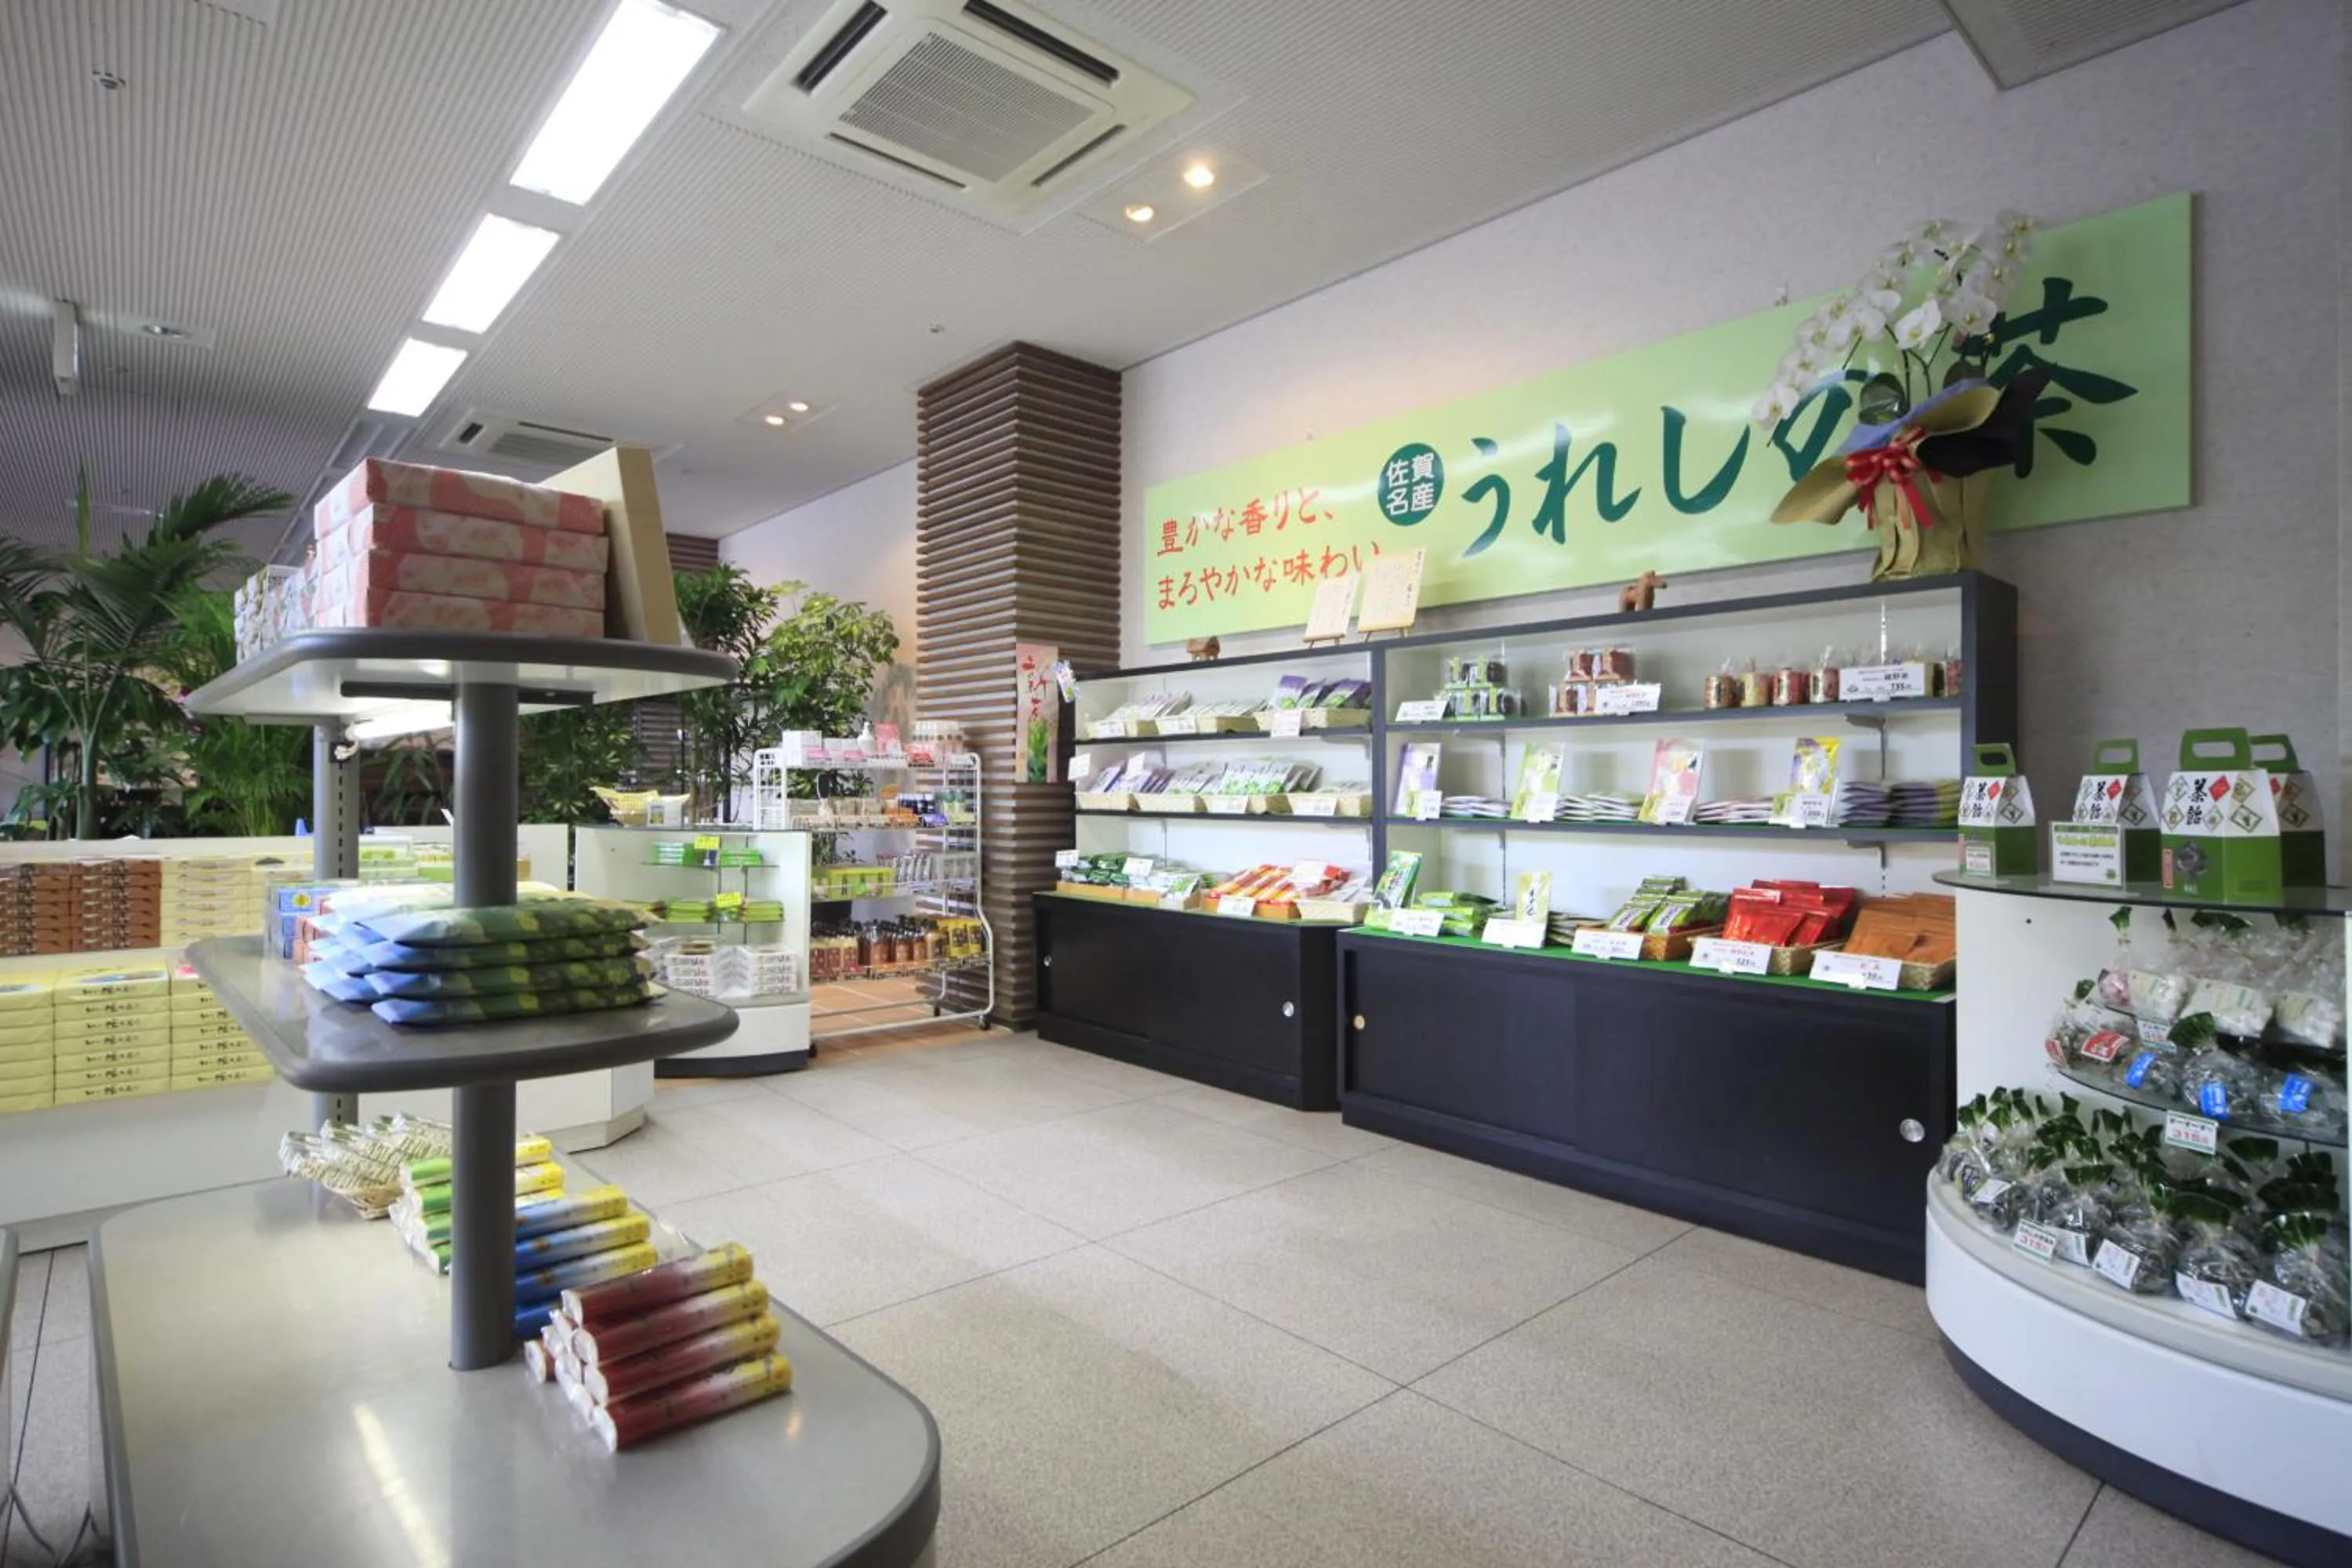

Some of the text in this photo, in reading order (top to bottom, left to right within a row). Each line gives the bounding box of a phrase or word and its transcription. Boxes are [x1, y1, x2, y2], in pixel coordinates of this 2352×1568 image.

[1387, 452, 1434, 488] 佐賀
[1156, 487, 1334, 557] 豊かな香りと、
[1386, 483, 1434, 515] 名産
[1156, 541, 1381, 610] まろやかな味わい
